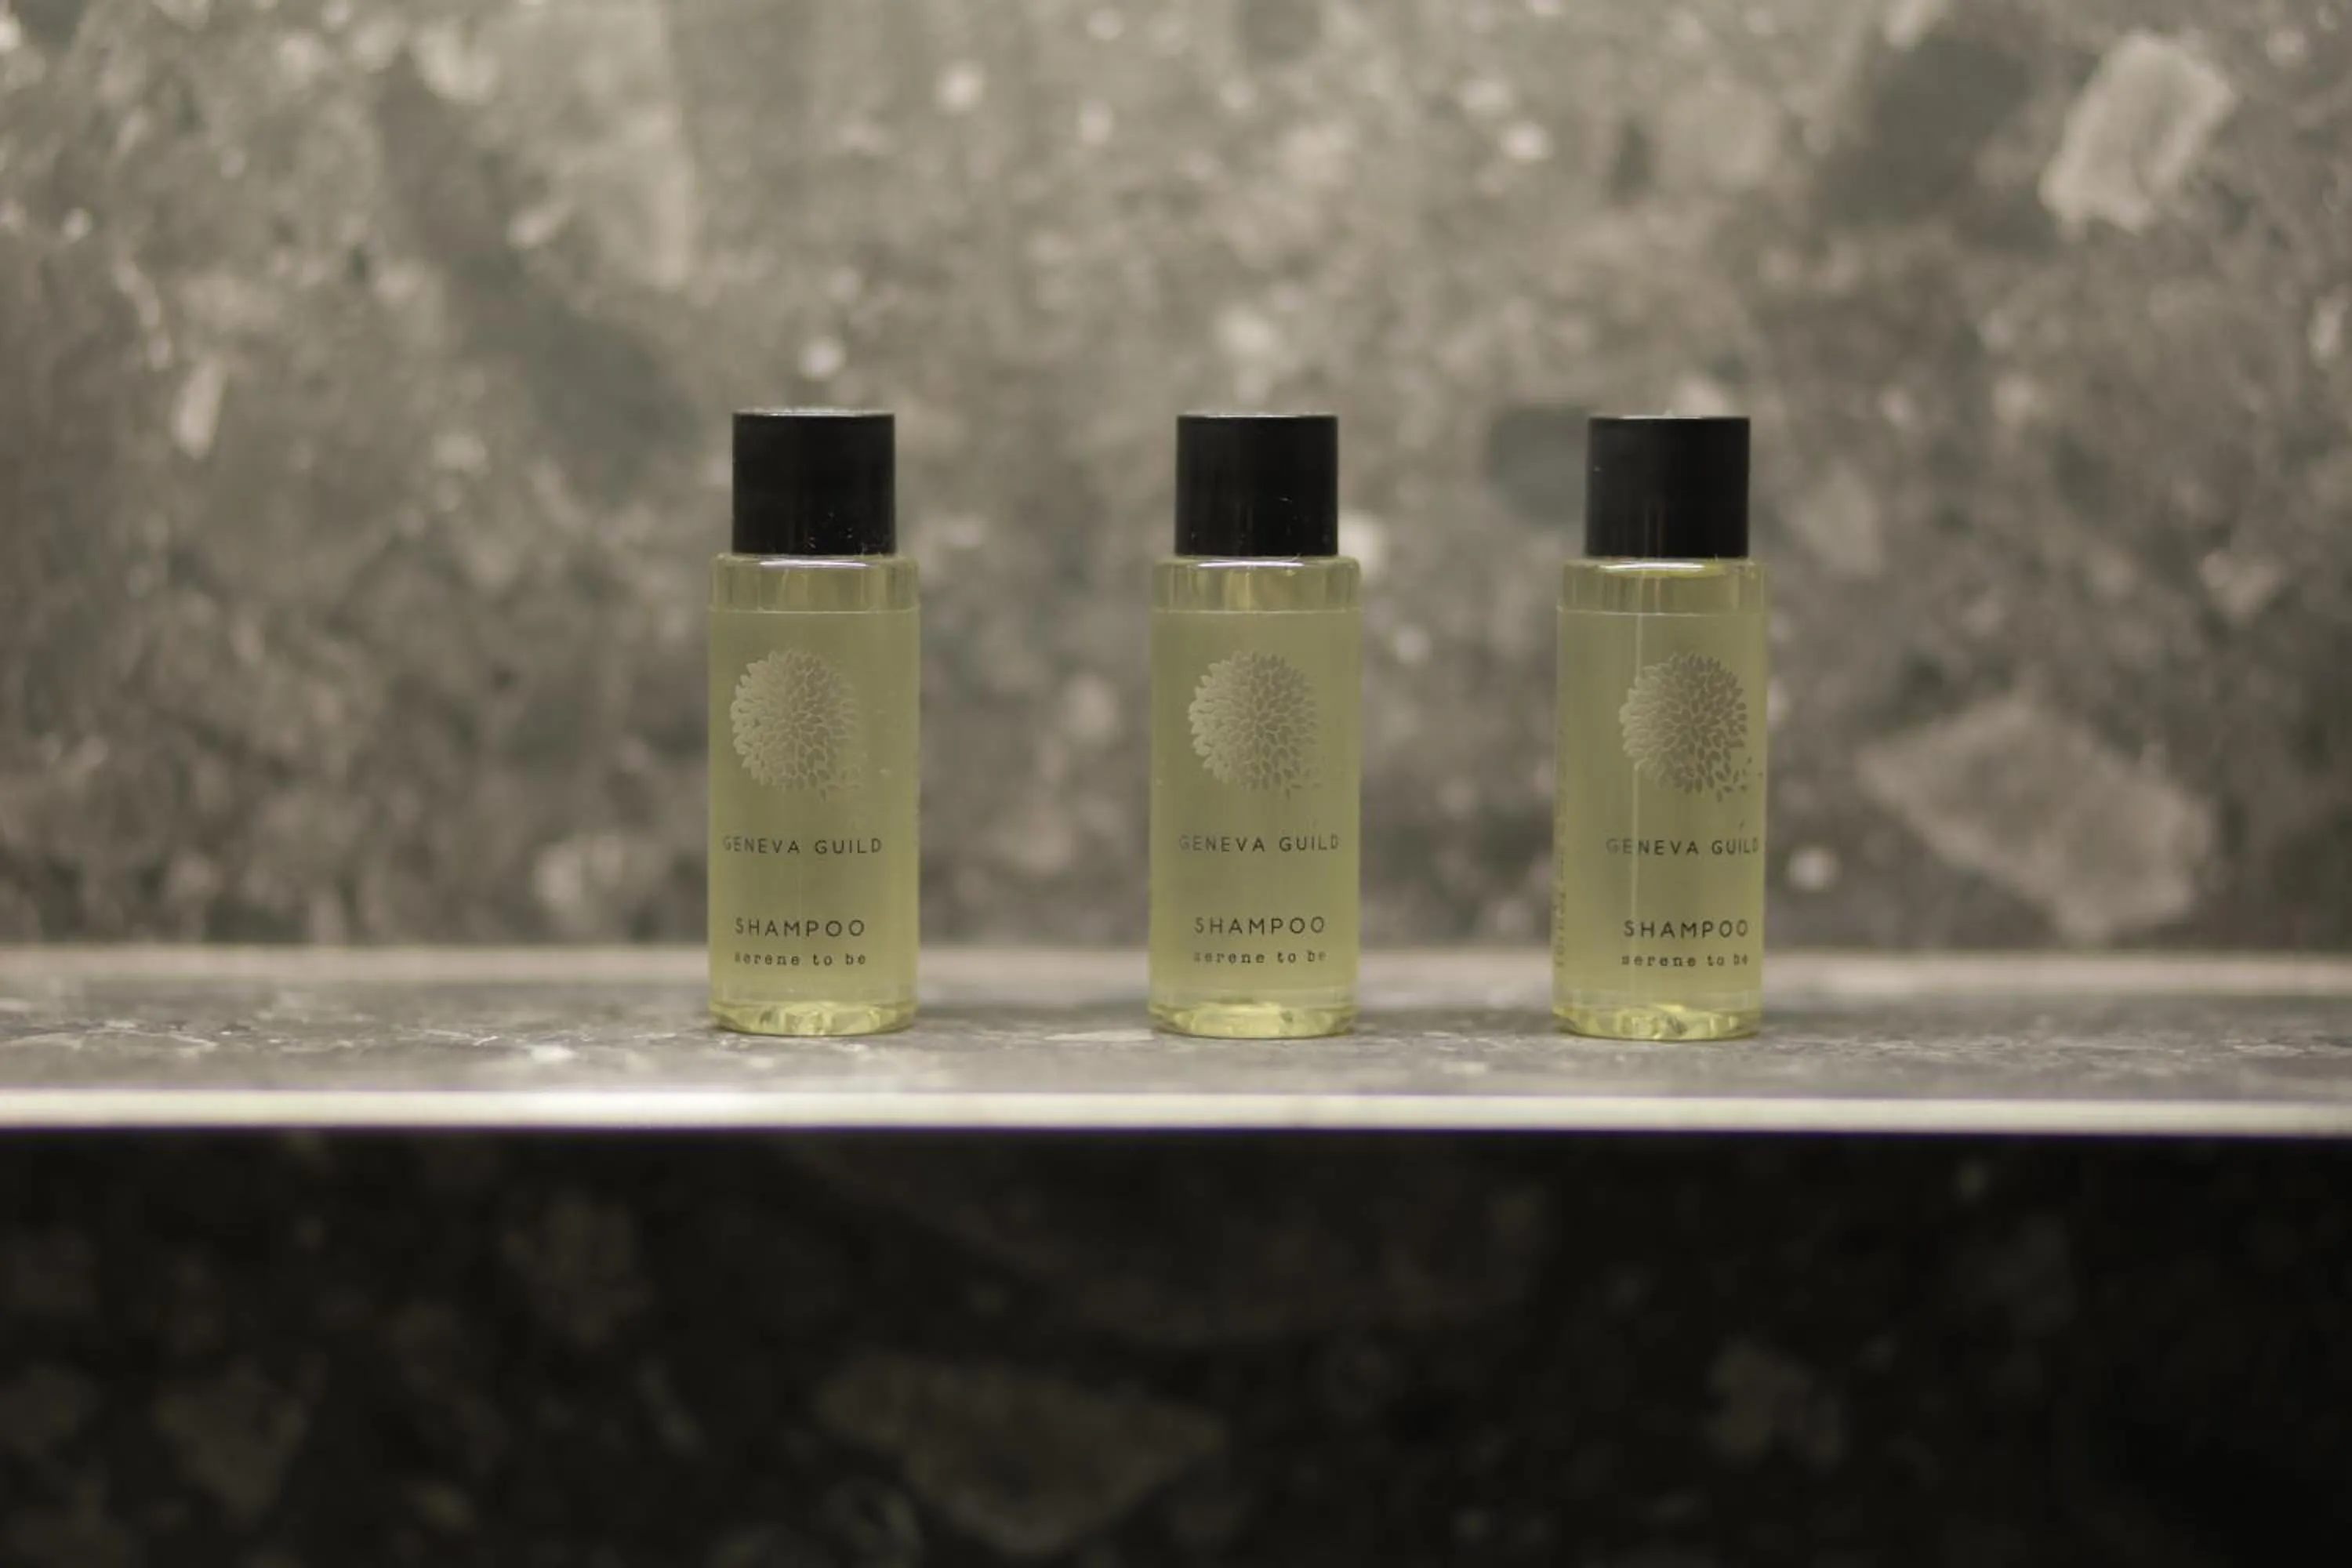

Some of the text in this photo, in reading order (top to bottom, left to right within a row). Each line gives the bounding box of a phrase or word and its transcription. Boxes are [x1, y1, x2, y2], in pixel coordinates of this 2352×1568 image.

[724, 837, 882, 855] GENEVA GUILD
[1178, 833, 1339, 852] GENEVA GUILD
[1606, 837, 1759, 855] GENEVA GUILD
[734, 916, 866, 937] SHAMPOO
[1193, 916, 1325, 935] SHAMPOO
[1624, 919, 1749, 938] SHAMPOO
[813, 953, 833, 966] to
[1277, 951, 1297, 964] to
[1707, 954, 1726, 967] to
